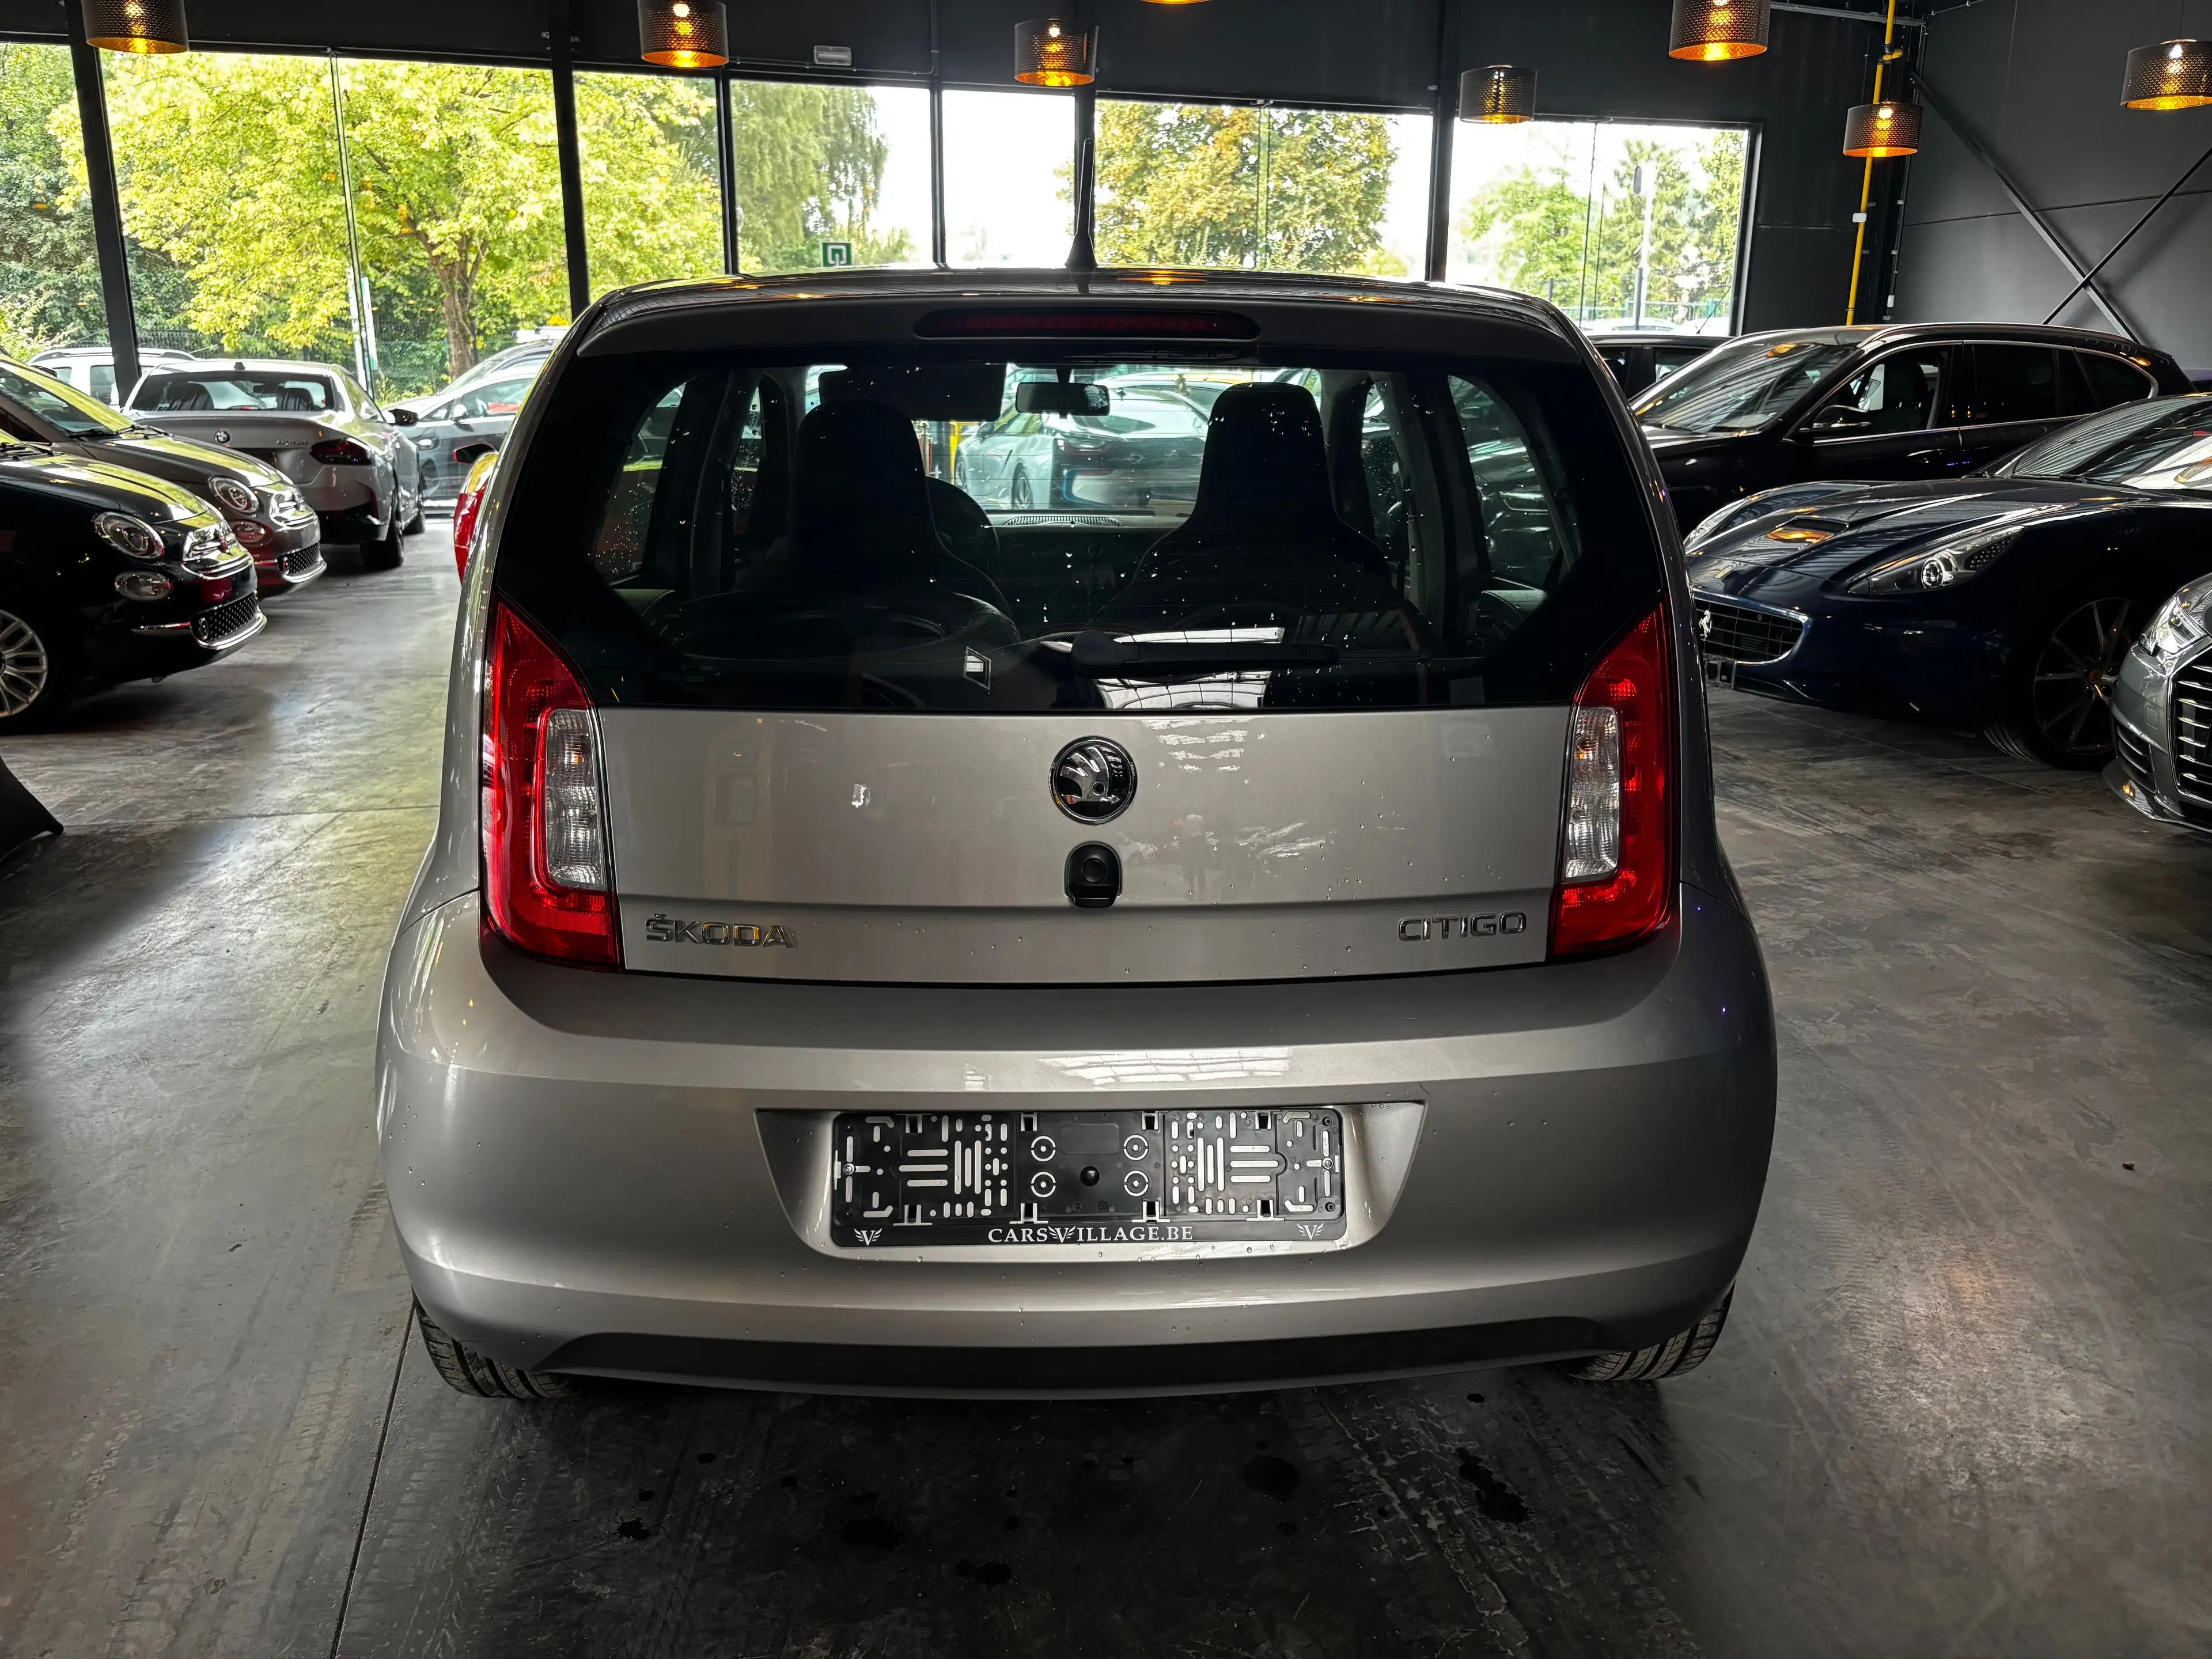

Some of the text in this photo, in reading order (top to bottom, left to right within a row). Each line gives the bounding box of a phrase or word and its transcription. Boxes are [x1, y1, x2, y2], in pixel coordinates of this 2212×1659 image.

[645, 913, 793, 948] ŠKODA
[1399, 911, 1527, 941] CITIGO
[987, 1225, 1193, 1243] CARSVILLAGE.BE
